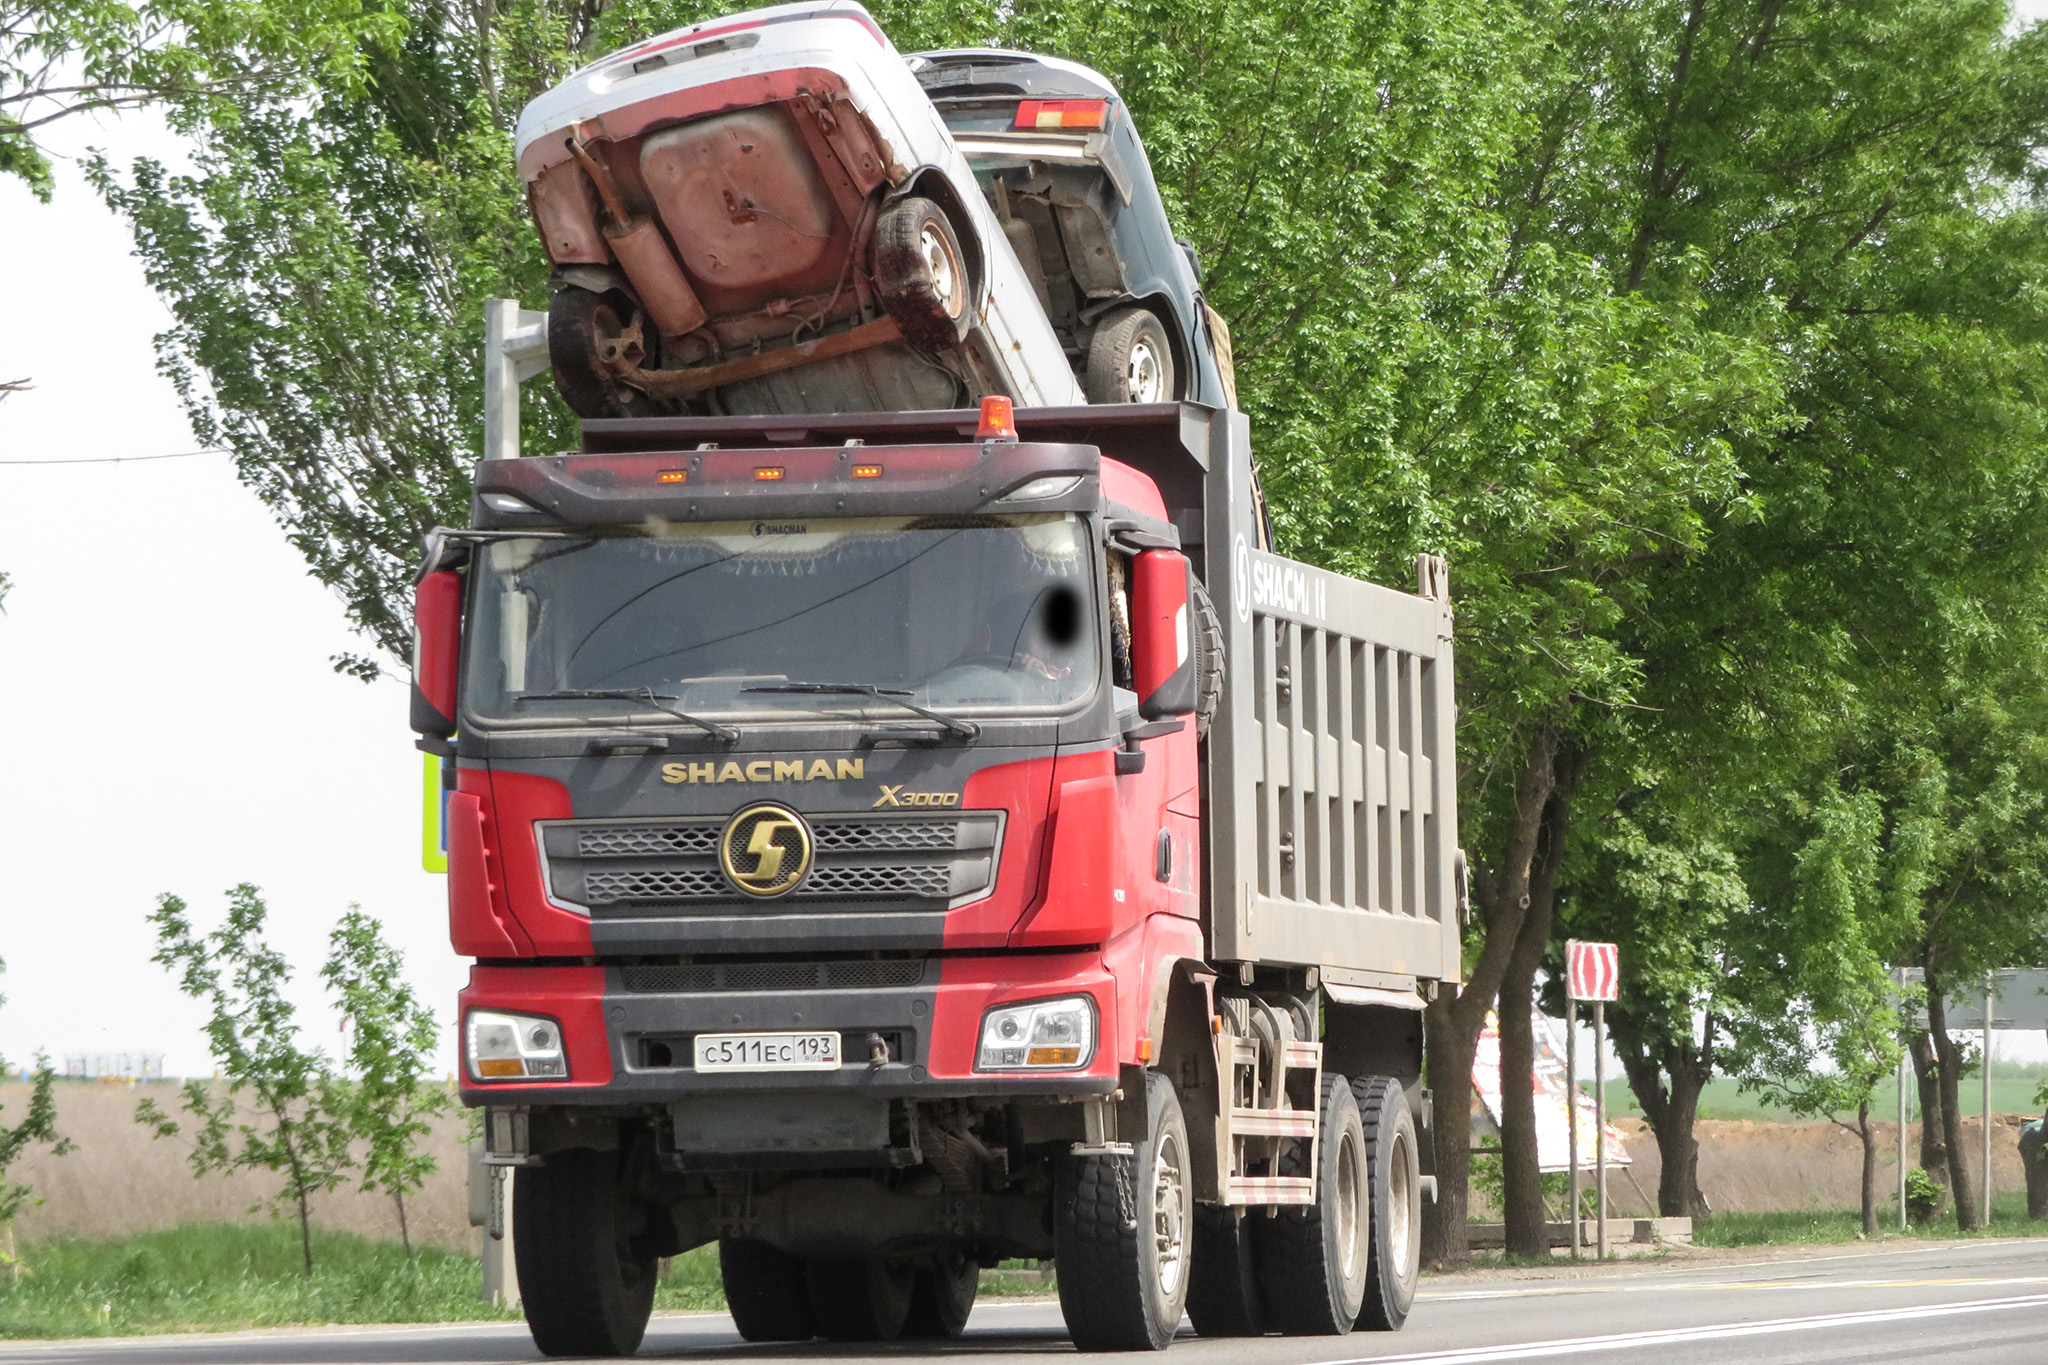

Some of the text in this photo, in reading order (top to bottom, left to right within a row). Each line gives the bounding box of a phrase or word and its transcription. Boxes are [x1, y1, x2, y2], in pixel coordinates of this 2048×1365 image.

[767, 524, 807, 535] SHACMAN
[661, 758, 865, 784] SHACMAN
[872, 784, 959, 808] X3000
[797, 1037, 831, 1055] 193
